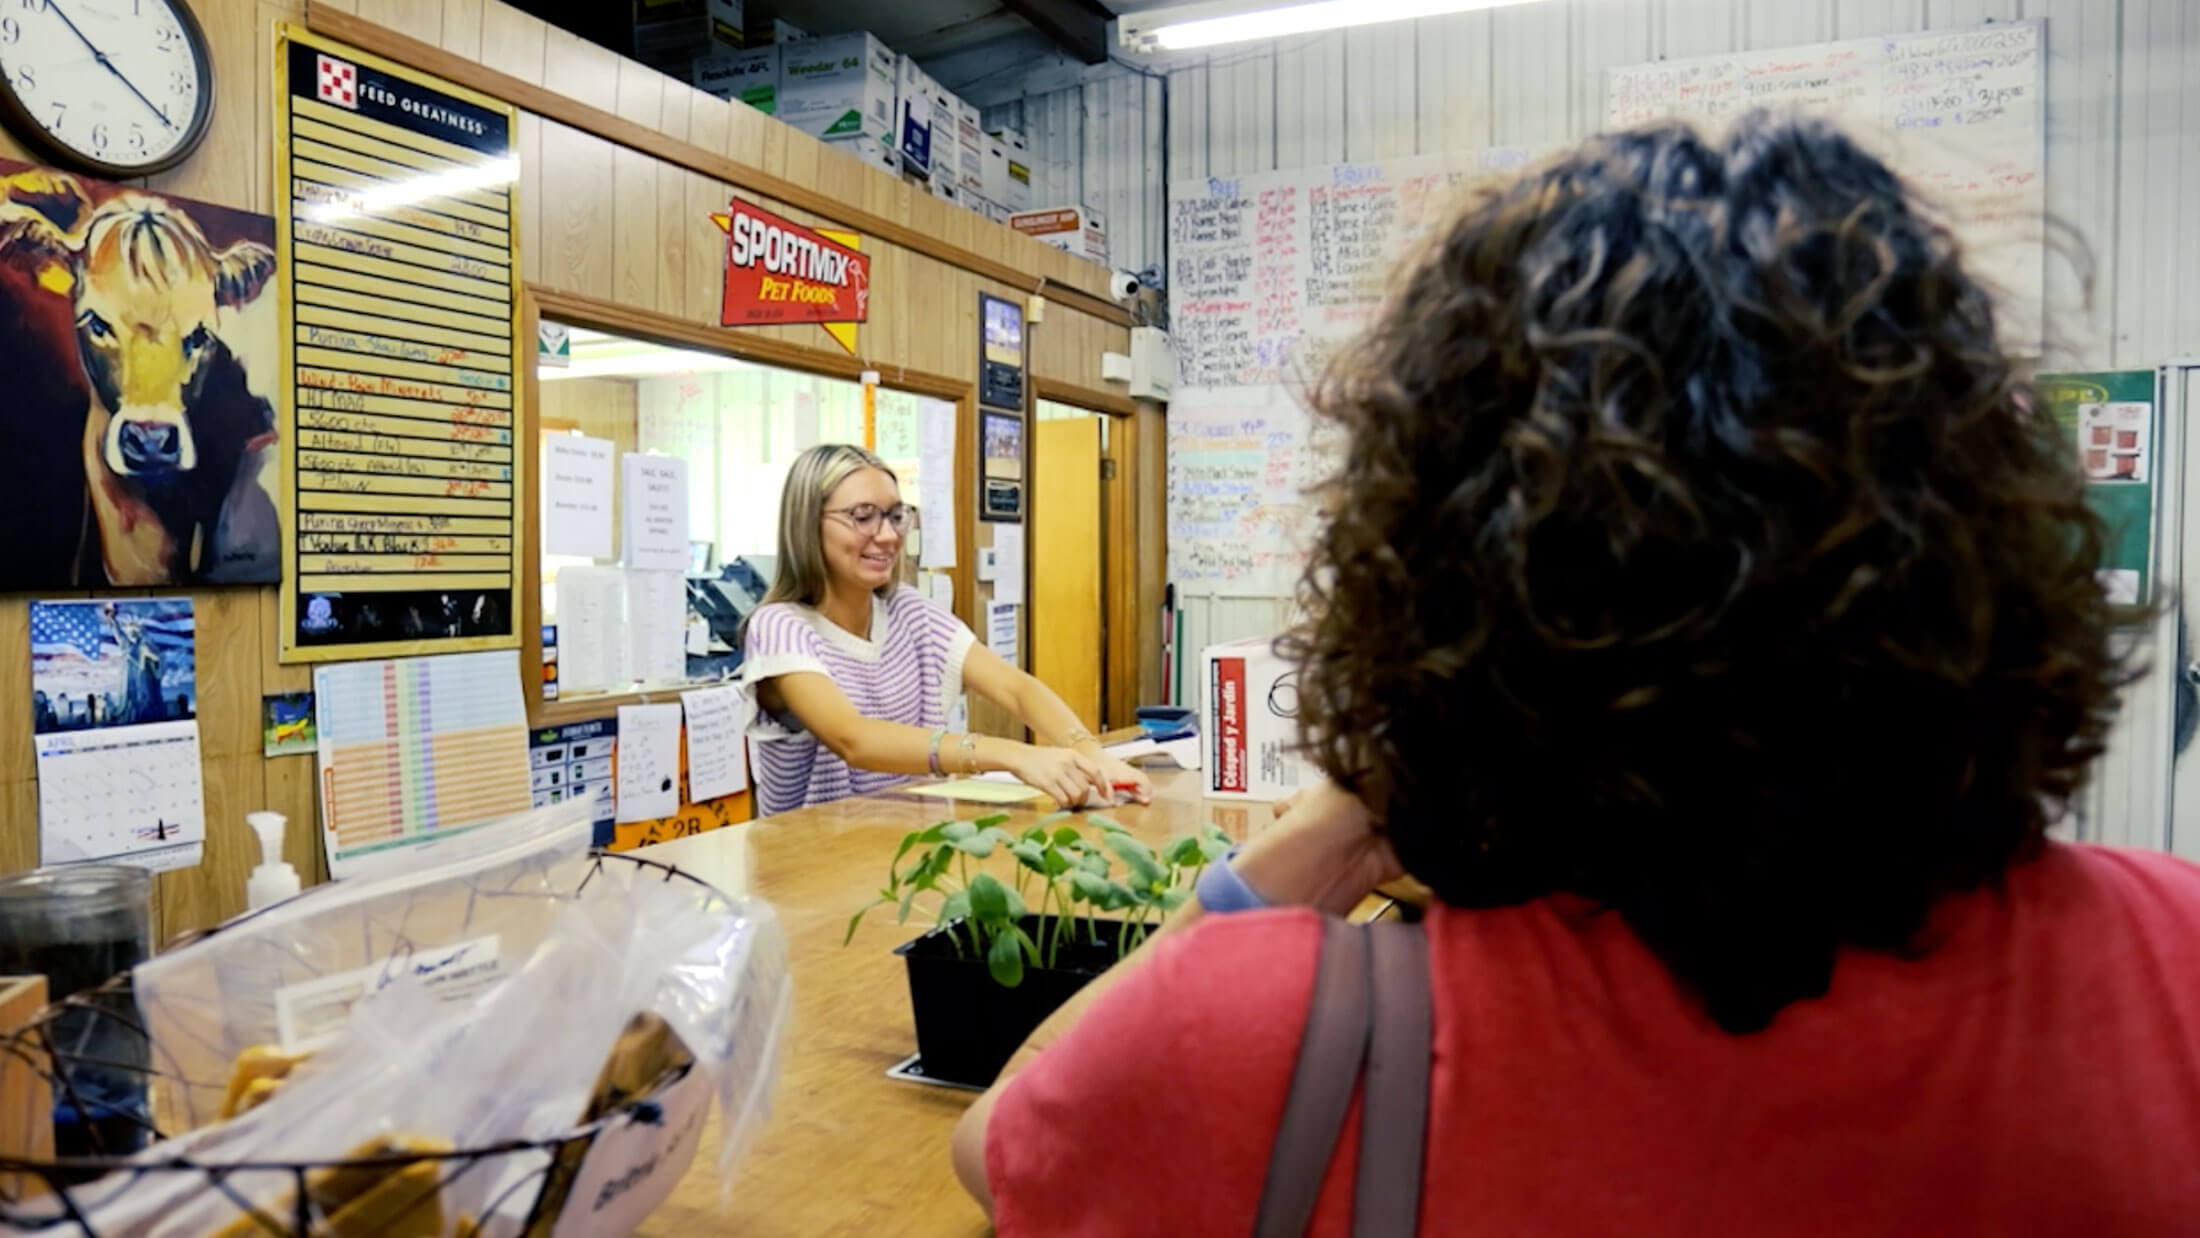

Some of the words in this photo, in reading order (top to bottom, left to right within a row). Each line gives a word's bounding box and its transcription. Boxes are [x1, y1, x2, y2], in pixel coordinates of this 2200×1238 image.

[2, 17, 20, 44] 9
[156, 27, 171, 52] 2
[18, 65, 36, 92] 8
[169, 71, 184, 95] 3
[51, 102, 67, 129] 7
[359, 84, 396, 106] FEED
[401, 98, 484, 136] GREATNESS
[92, 123, 108, 149] 6
[129, 122, 145, 148] 5
[759, 276, 790, 300] PET
